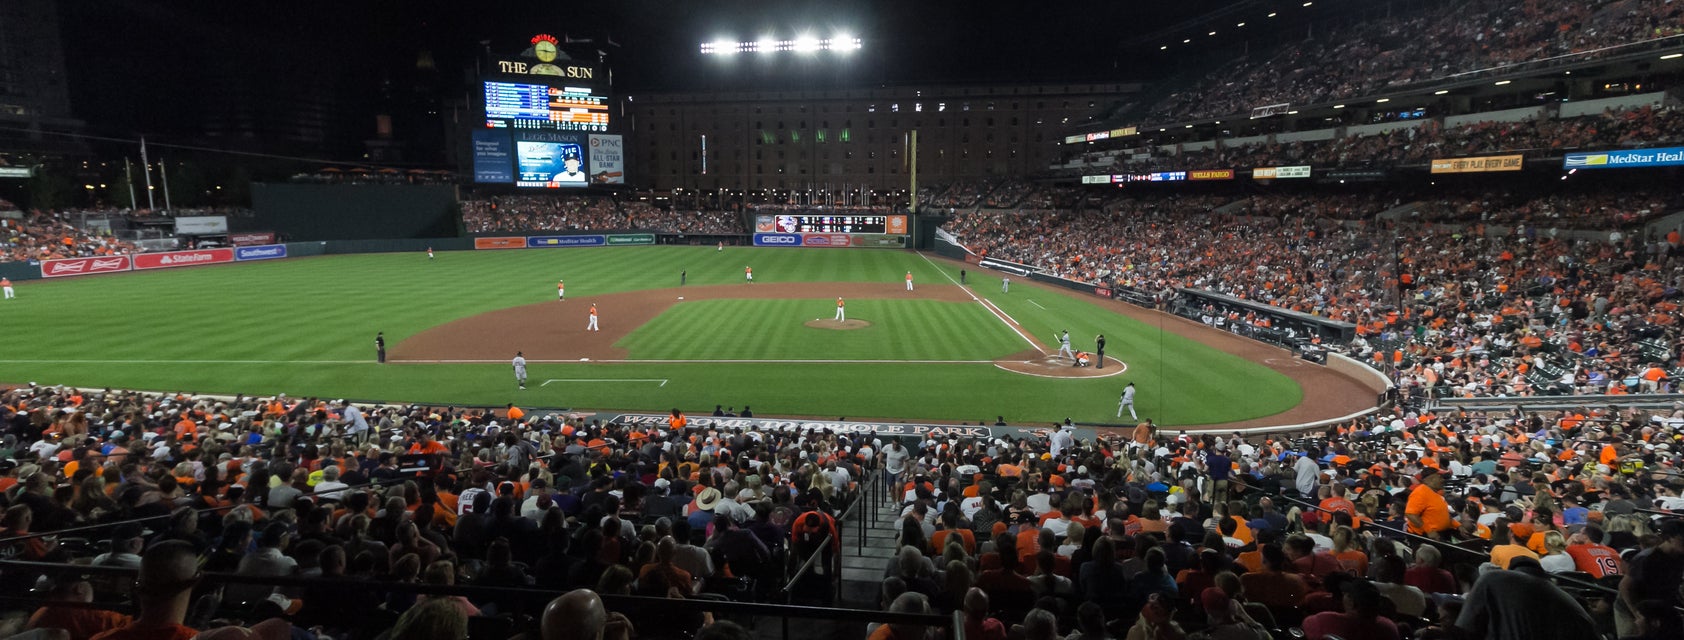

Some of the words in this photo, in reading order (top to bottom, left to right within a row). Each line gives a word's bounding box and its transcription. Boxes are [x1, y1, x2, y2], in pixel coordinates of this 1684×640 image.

[499, 61, 528, 74] THE
[567, 66, 592, 78] SUN
[523, 132, 546, 140] LEGG
[549, 134, 579, 142] MASON
[601, 139, 620, 147] PNC
[1609, 154, 1654, 164] MedStar
[1656, 151, 1684, 162] Heal
[1453, 161, 1469, 170] EVERY
[1485, 160, 1502, 169] EVERY
[241, 248, 277, 257] Southwest
[624, 415, 752, 428] WELOME
[914, 426, 985, 436] PARK
[1596, 557, 1619, 576] 19
